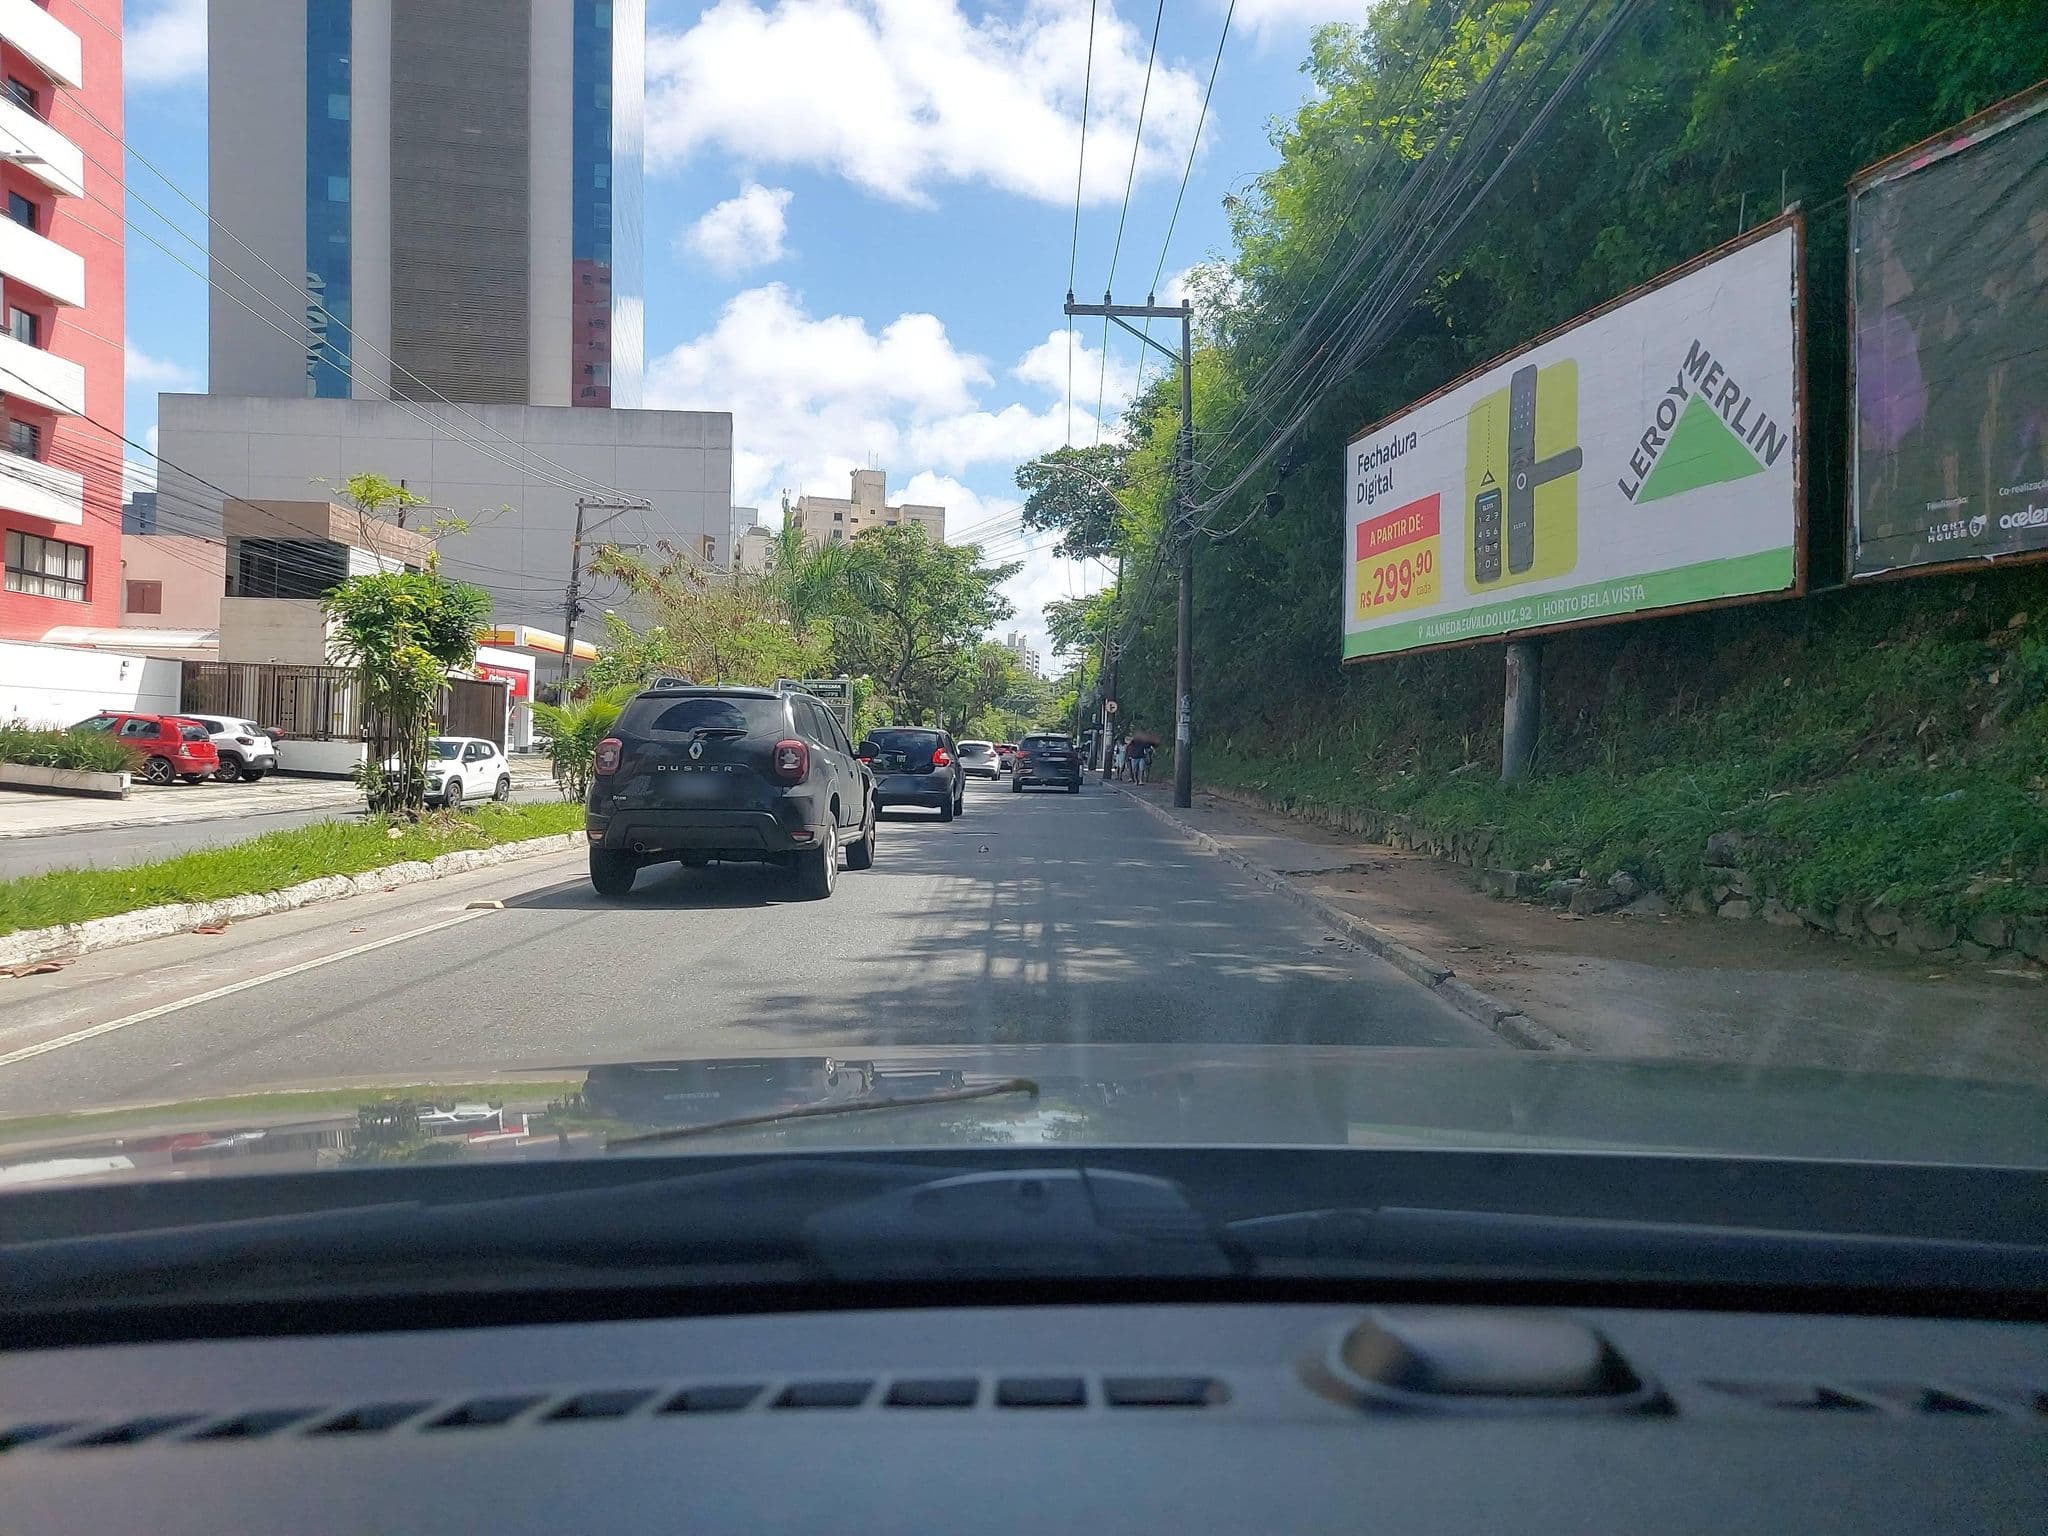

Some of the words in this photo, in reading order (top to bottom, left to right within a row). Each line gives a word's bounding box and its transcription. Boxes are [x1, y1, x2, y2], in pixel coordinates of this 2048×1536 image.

[1618, 370, 1689, 501] LEROY
[1683, 338, 1788, 467] MERLIN
[1357, 431, 1417, 475] Fechadura
[1357, 467, 1394, 505] Digital
[1369, 531, 1376, 547] A
[1376, 519, 1407, 545] PARTIR
[1408, 513, 1424, 533] DE:
[1927, 529, 1968, 543] HOUSE
[1929, 520, 1965, 534] LIGHT
[1360, 590, 1372, 609] R$
[1373, 549, 1432, 606] 299,90
[1416, 584, 1432, 596] cada
[1426, 621, 1461, 638] ALAMEDA
[1519, 606, 1532, 621] 92
[1542, 596, 1579, 617] HORTO
[1580, 591, 1610, 610] BELA
[1611, 584, 1645, 604] VISTA
[657, 764, 734, 772] DUSTER
